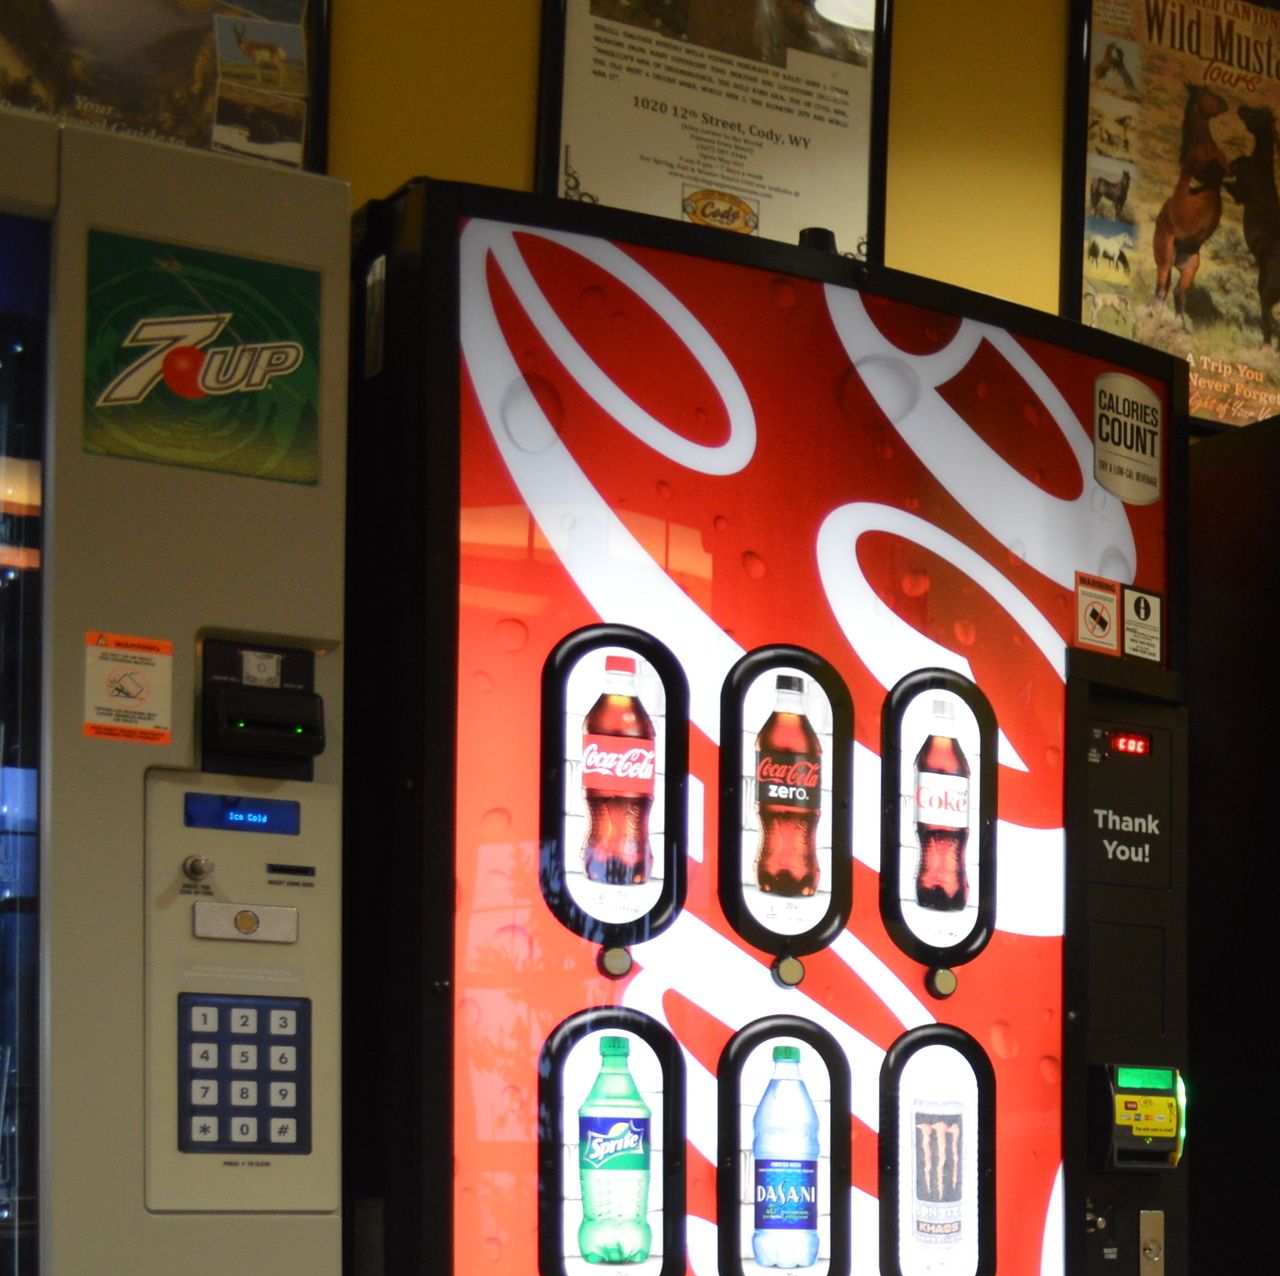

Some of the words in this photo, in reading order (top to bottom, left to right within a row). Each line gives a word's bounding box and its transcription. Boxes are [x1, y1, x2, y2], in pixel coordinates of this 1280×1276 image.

[1223, 0, 1280, 30] CANYON
[1144, 0, 1202, 57] Wild
[1200, 58, 1262, 93] Tours
[74, 94, 114, 116] Your
[632, 95, 668, 114] 1020
[702, 111, 747, 136] Street,
[749, 123, 786, 146] Cody,
[789, 134, 812, 151] WY
[701, 201, 740, 225] Cody
[1186, 353, 1197, 368] A
[1200, 355, 1233, 378] Trip
[1236, 363, 1265, 384] You
[1188, 371, 1231, 393] Never
[1098, 389, 1159, 428] CALORIES
[1097, 413, 1158, 458] COUNT
[582, 742, 656, 781] Coca-Cola
[756, 755, 822, 788] Coca-Cola
[914, 785, 969, 814] Coke
[228, 811, 244, 822] Ice
[246, 812, 268, 825] Cold
[1093, 808, 1160, 835] Thank
[1103, 839, 1150, 863] You!
[201, 1013, 208, 1025] 1
[240, 1014, 250, 1027] 2
[279, 1016, 288, 1029] 3
[200, 1049, 210, 1062] 4
[240, 1051, 249, 1064] 5
[279, 1052, 288, 1065] 6
[200, 1086, 210, 1099] 7
[240, 1087, 249, 1100] 8
[279, 1088, 288, 1101] 9
[240, 1123, 249, 1136] 0
[590, 1131, 640, 1161] Sprite
[757, 1181, 816, 1206] DASANI
[918, 1221, 960, 1234] KHAOS
